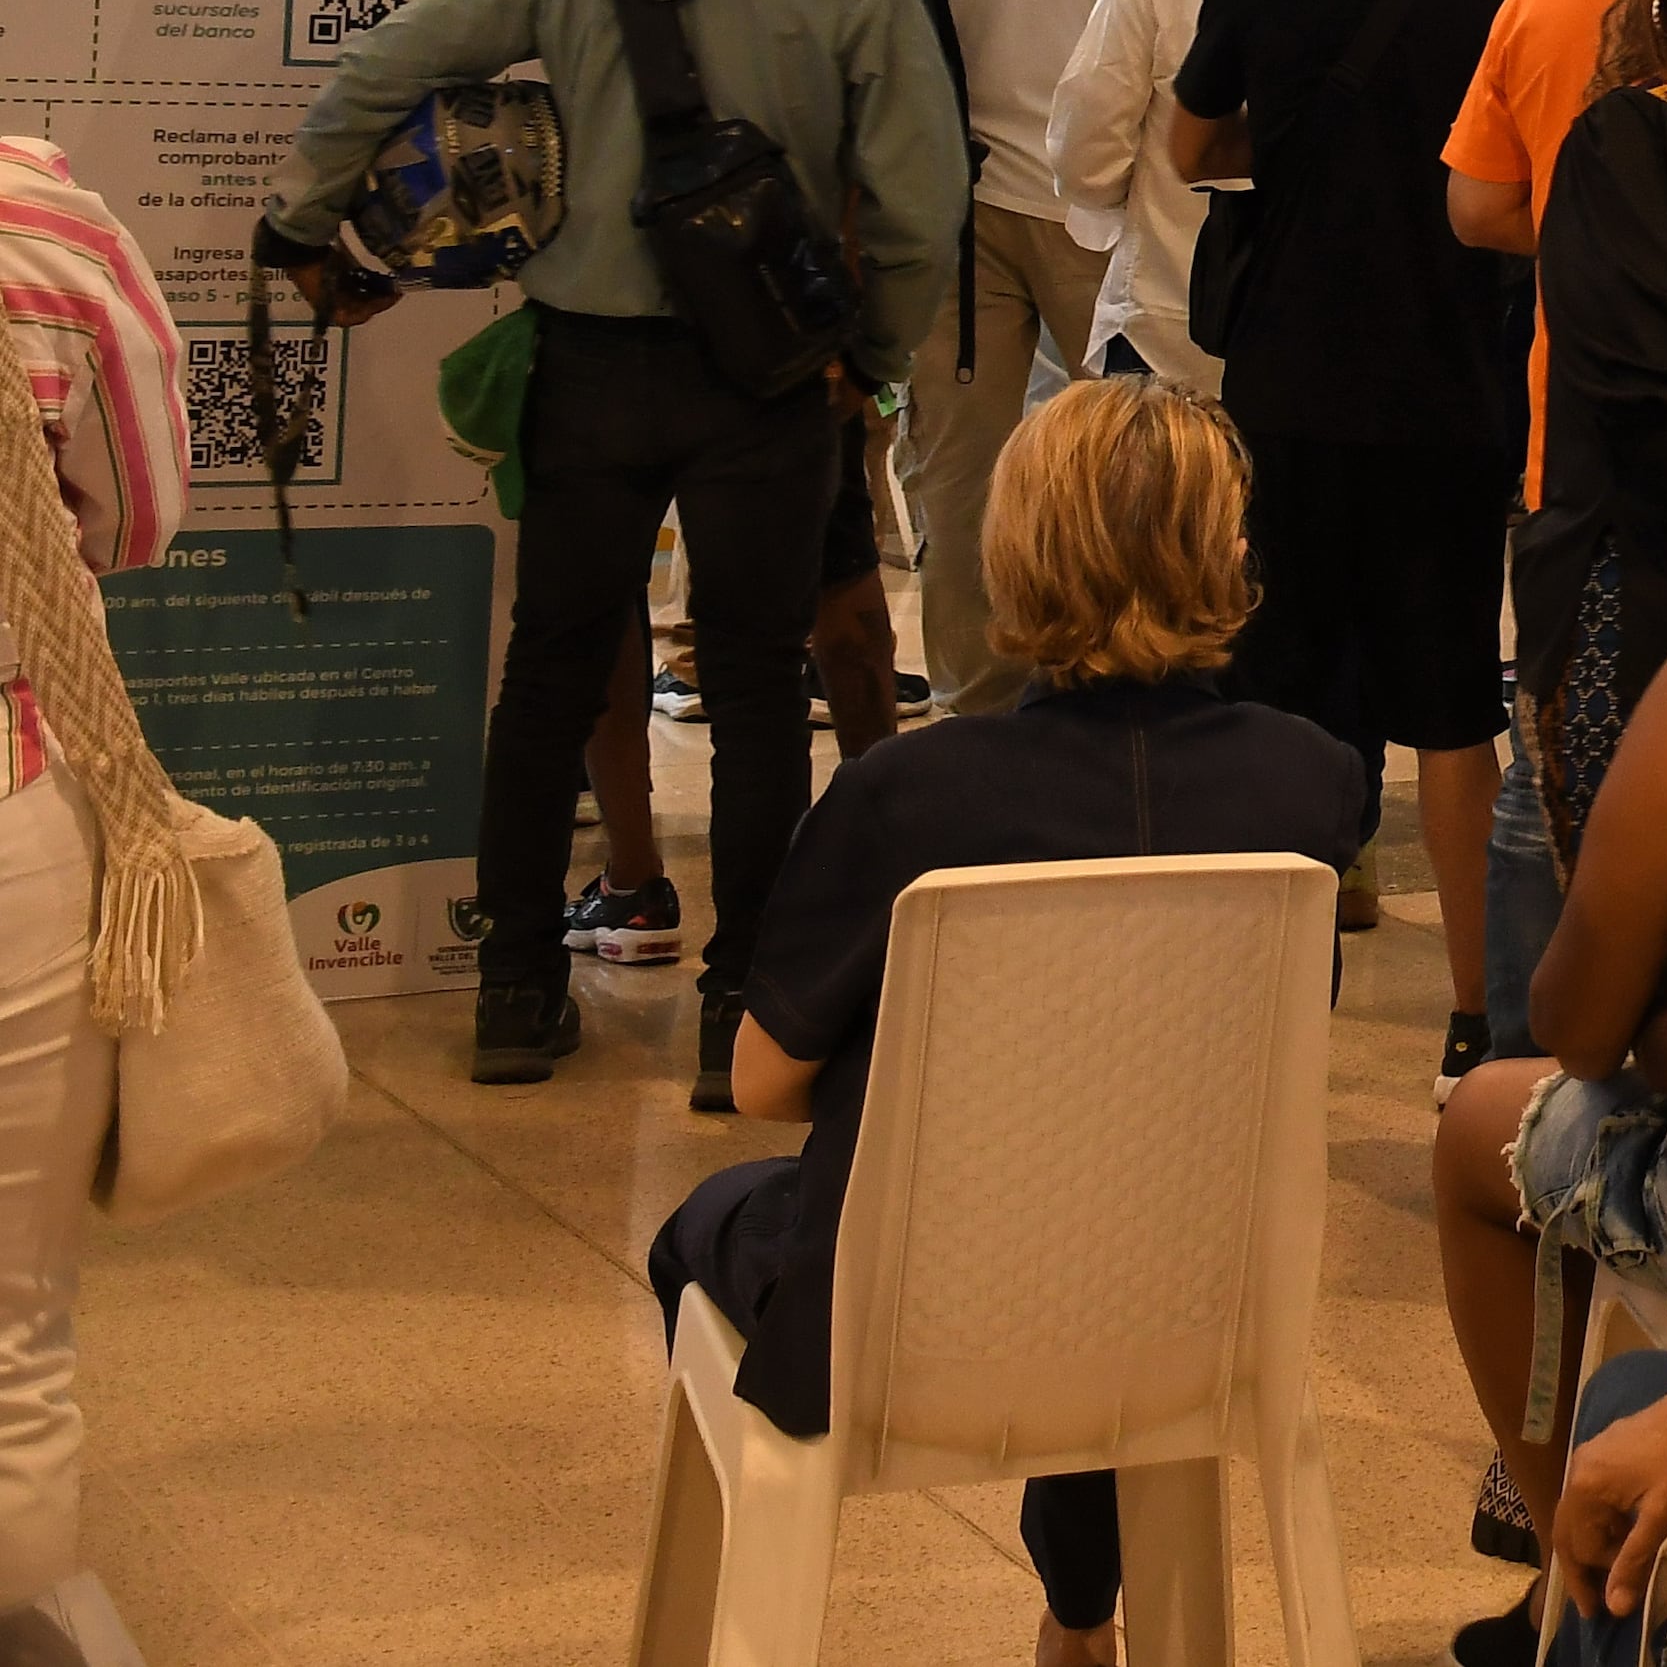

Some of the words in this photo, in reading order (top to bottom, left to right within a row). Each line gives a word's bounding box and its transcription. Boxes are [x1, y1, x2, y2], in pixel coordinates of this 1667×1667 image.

[152, 2, 260, 19] sucursales
[156, 22, 187, 38] del
[191, 24, 256, 39] banco
[152, 129, 237, 145] Reclama
[242, 130, 260, 145] el
[201, 172, 258, 187] antes
[138, 192, 163, 207] de
[168, 192, 185, 207] la
[190, 193, 256, 208] oficina
[173, 246, 245, 264] Ingresa
[206, 289, 217, 303] 5
[211, 672, 249, 685] Valle
[361, 667, 414, 680] Centro
[334, 936, 381, 953] Valle
[308, 951, 404, 971] Invencible
